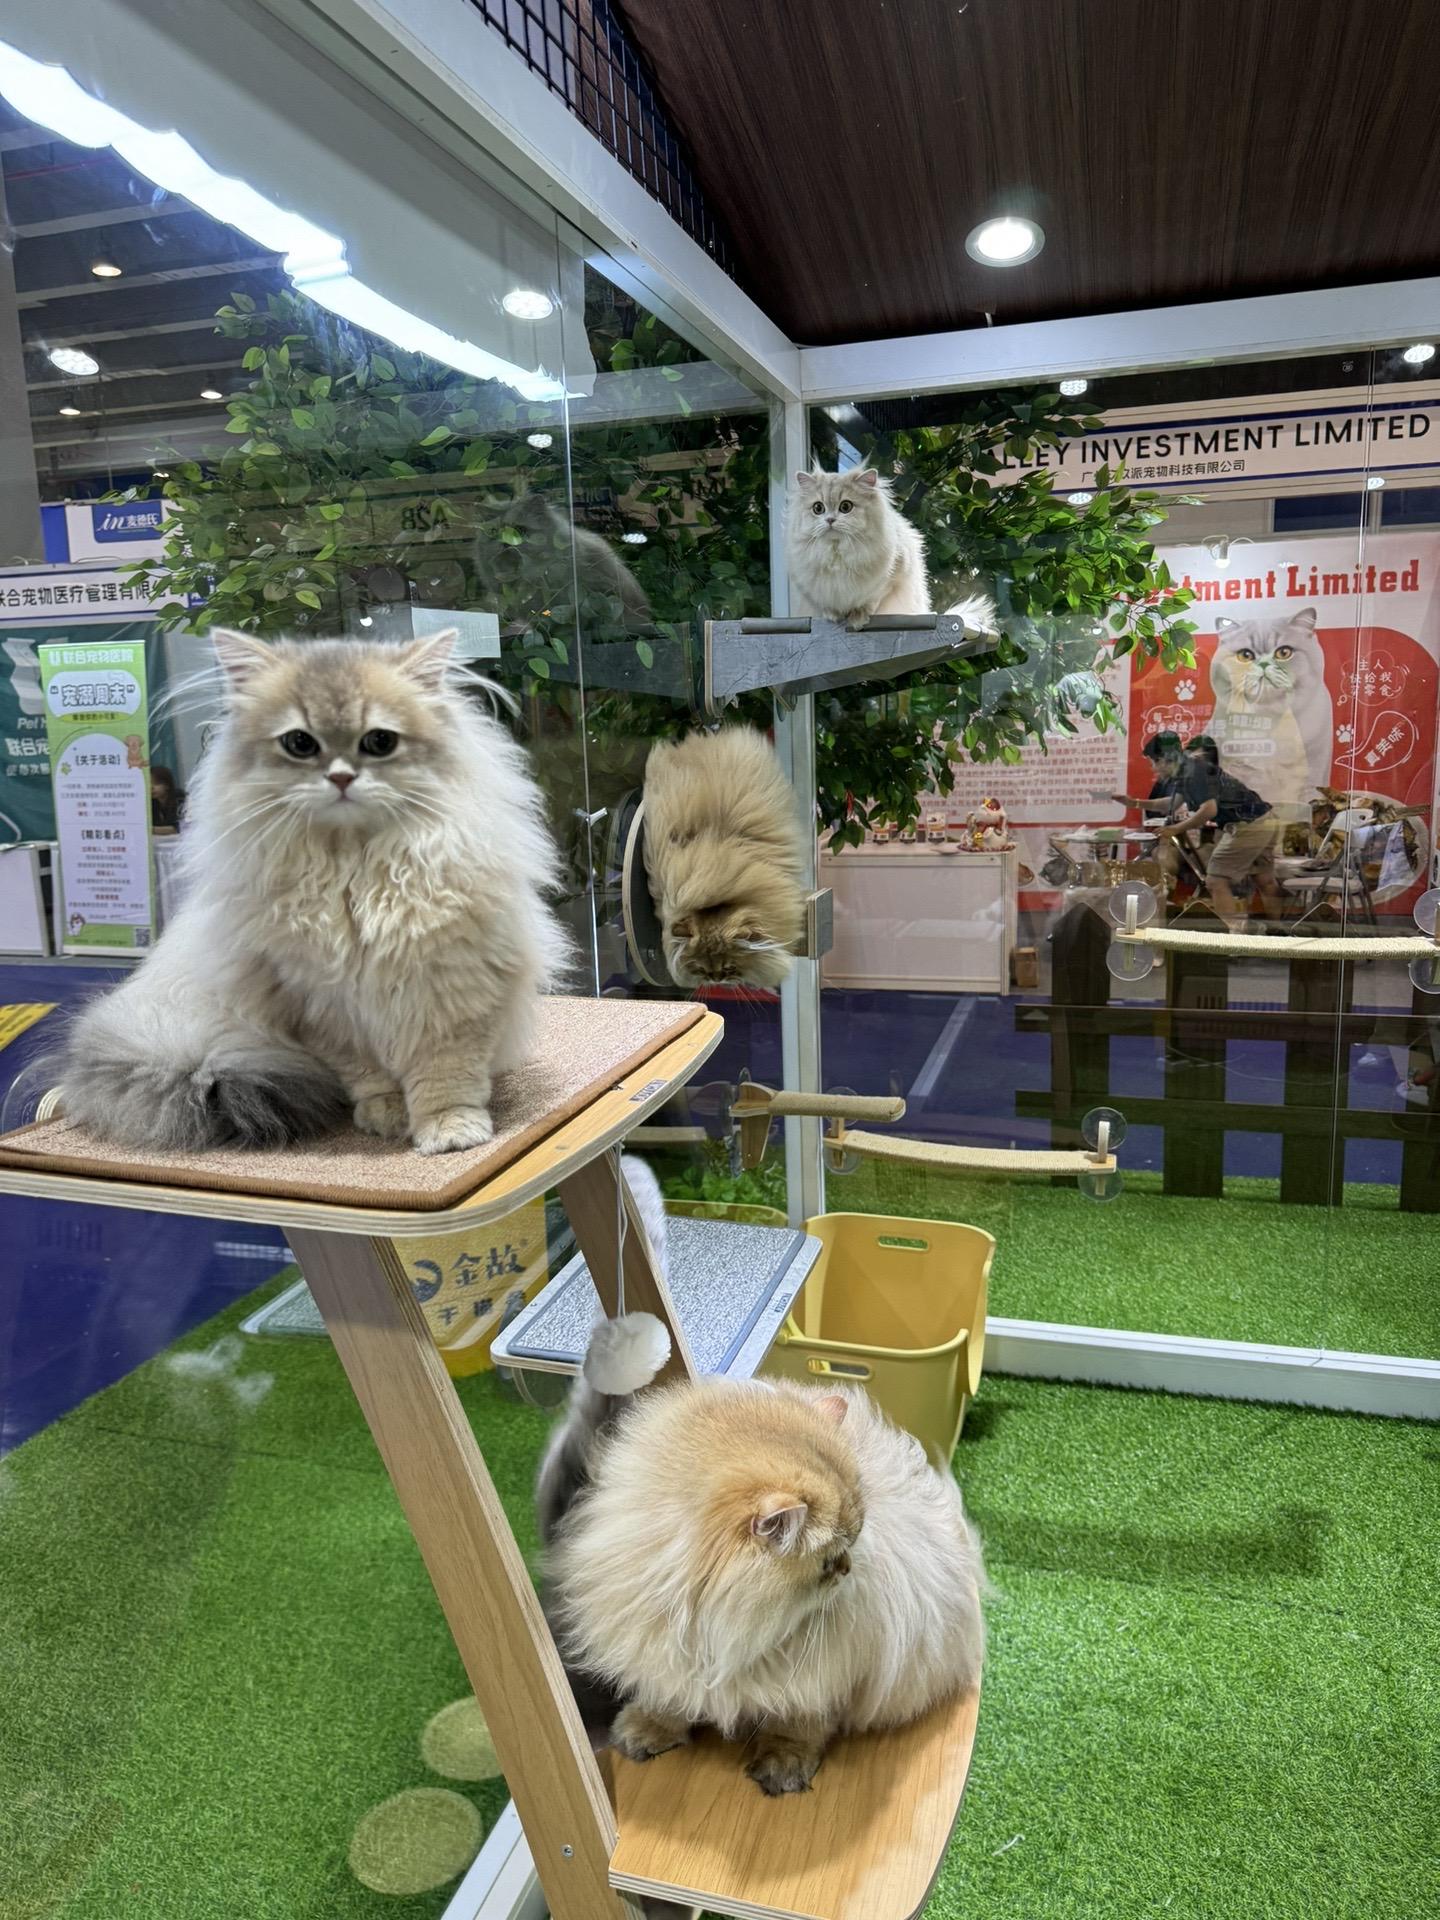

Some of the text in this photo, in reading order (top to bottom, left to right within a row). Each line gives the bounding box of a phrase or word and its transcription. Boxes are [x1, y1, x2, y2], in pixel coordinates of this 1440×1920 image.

[1081, 425, 1284, 463] INVESTMENT
[1295, 413, 1431, 447] LIMITED
[1081, 459, 1245, 484] 广派宠物科技有限公司
[0, 580, 184, 607] 合宠物医疗管理有限
[1286, 558, 1420, 597] Limited
